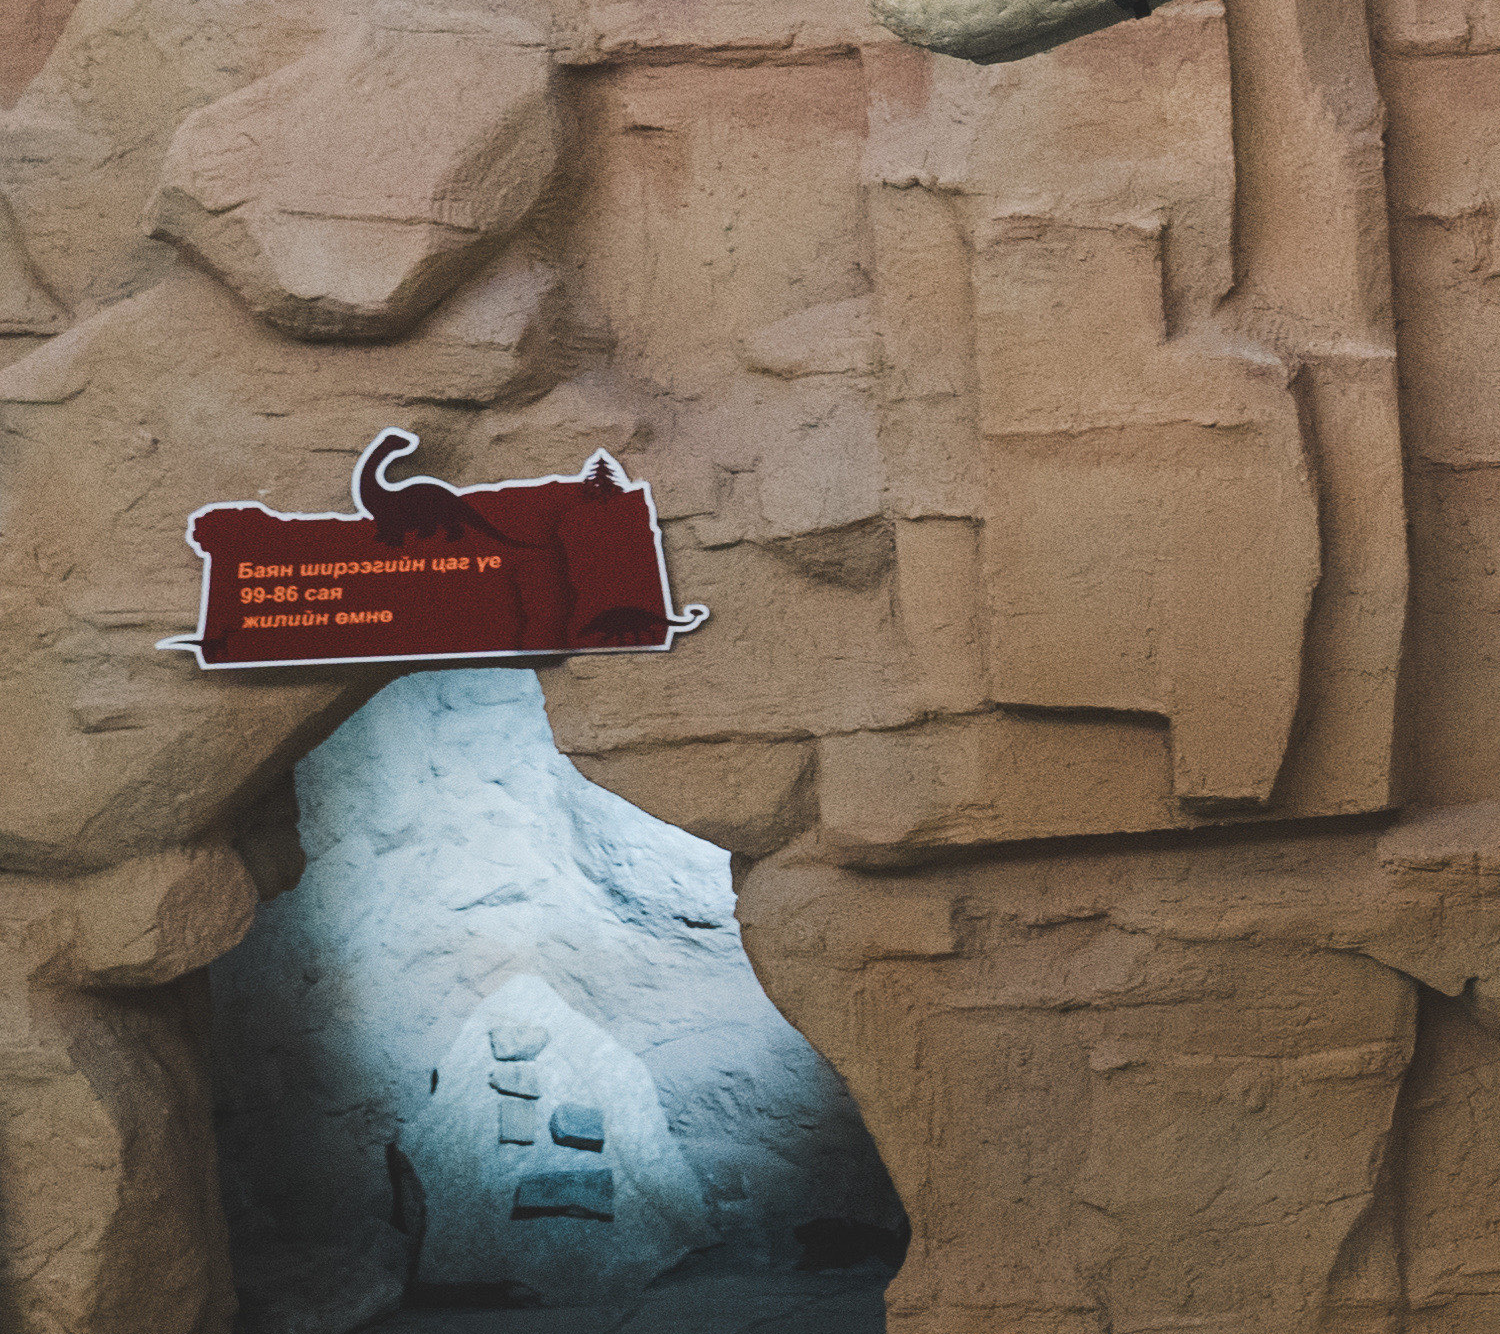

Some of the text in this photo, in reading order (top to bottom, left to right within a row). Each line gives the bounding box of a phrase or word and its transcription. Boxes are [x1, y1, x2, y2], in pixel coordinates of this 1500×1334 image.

[238, 554, 502, 580] Баян ширээгийн цаг үе
[241, 586, 343, 604] 99-86 сая
[242, 609, 393, 629] жилийн өмнө
